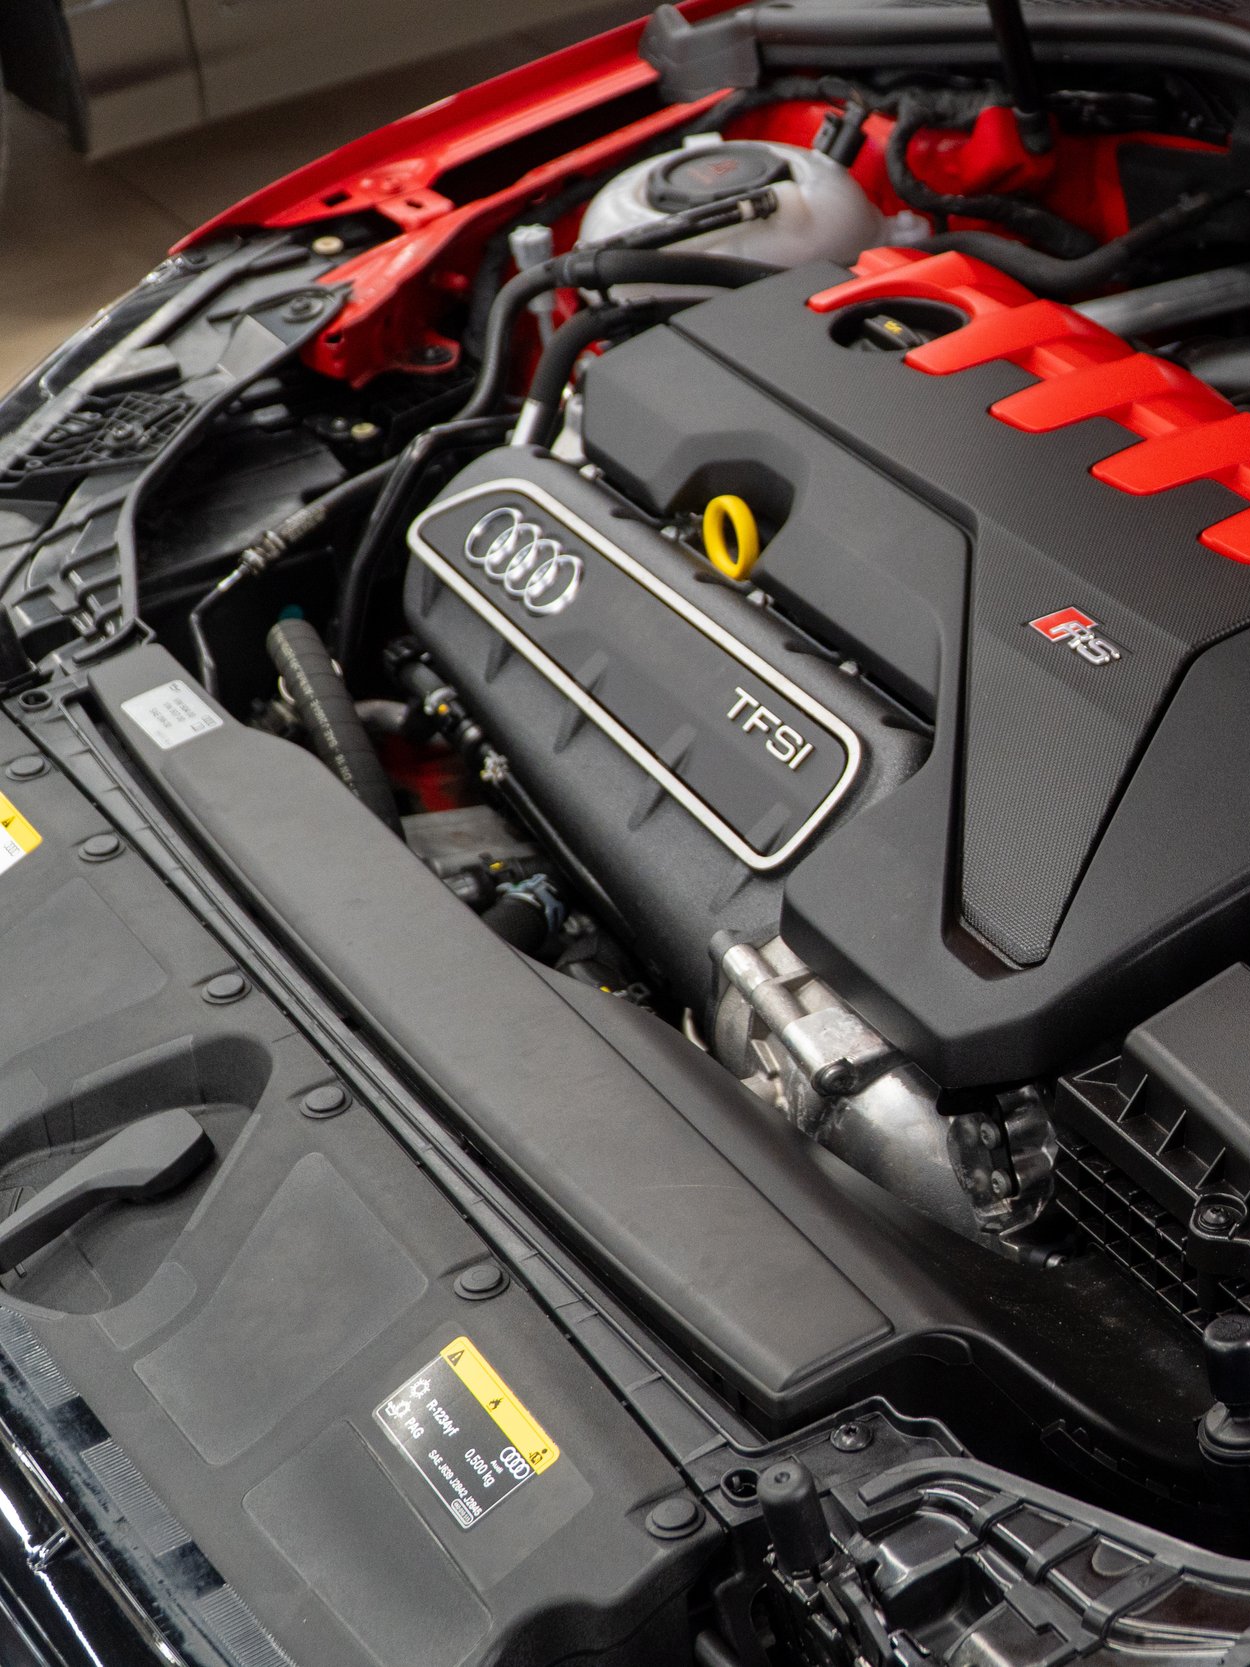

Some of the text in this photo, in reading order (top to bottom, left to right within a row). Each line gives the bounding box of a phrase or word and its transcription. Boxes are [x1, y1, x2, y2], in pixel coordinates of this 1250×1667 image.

[1049, 620, 1121, 665] RS
[726, 686, 814, 770] TFSI
[404, 1416, 425, 1439] PAG
[426, 1398, 460, 1437] R-1234yf
[428, 1449, 444, 1466] SAE
[438, 1463, 454, 1480] J639
[464, 1448, 496, 1488] 0,500 kg
[490, 1459, 504, 1474] Audi
